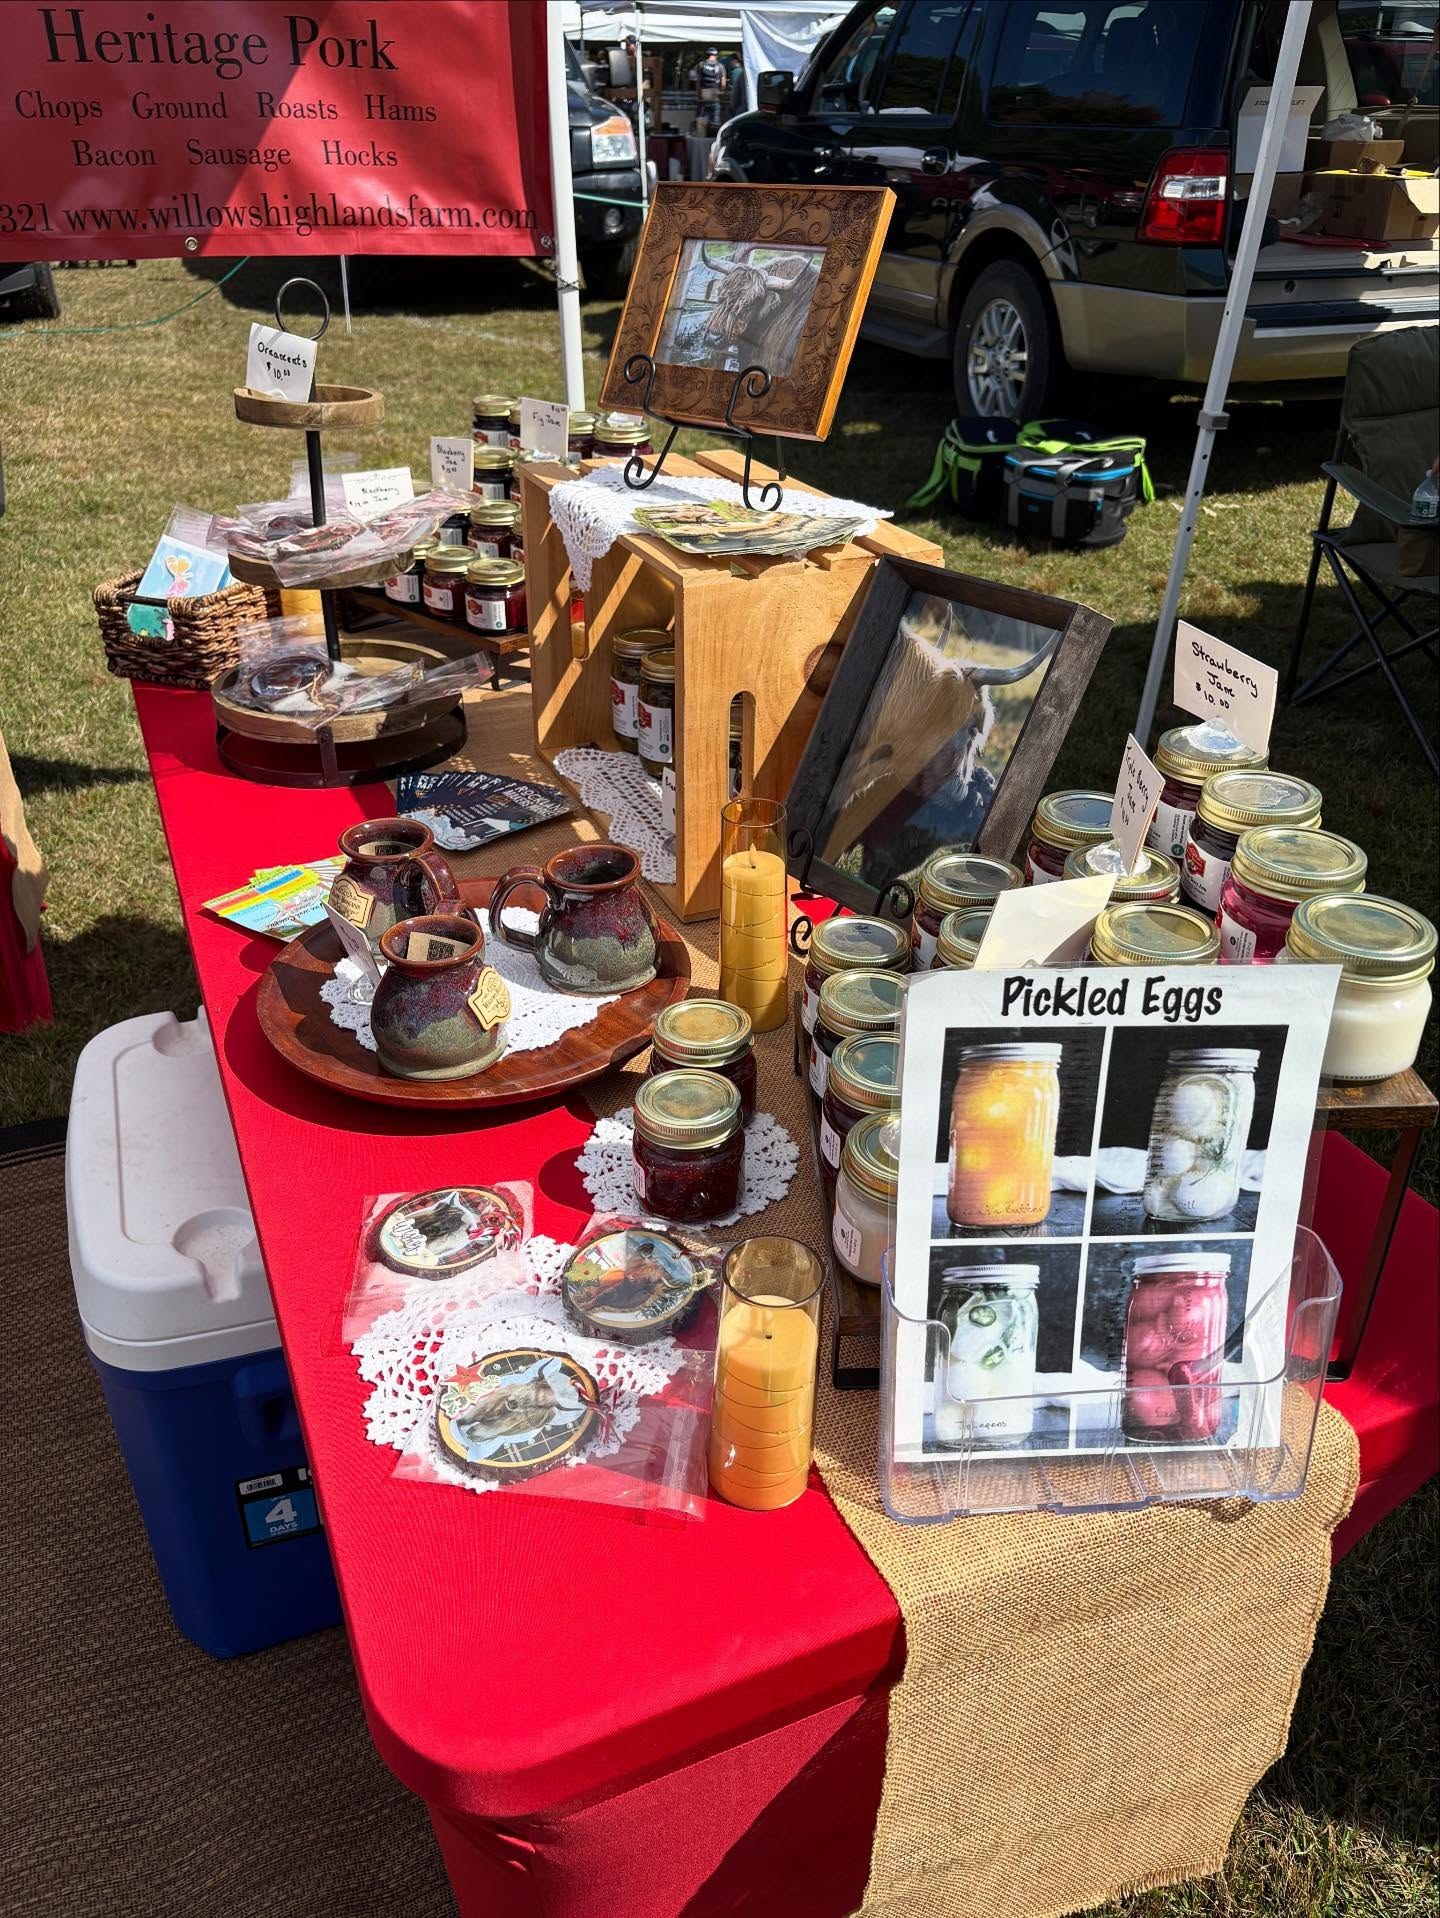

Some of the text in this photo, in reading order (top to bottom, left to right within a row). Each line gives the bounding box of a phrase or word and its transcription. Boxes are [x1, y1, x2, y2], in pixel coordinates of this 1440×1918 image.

[40, 8, 399, 81] Heritage Pork
[15, 88, 438, 127] Chops Ground Roasts Hams
[73, 139, 399, 173] Bacon Sausage Hocks
[0, 193, 538, 237] 321 www.willowshighlandsfarm.com
[257, 341, 308, 368] Ornaments
[1191, 641, 1259, 699] Strawberry
[1206, 671, 1236, 698] Jam
[1001, 974, 1224, 1022] Pickled Eggs
[265, 1498, 298, 1523] 4
[269, 1521, 298, 1533] DAYS
